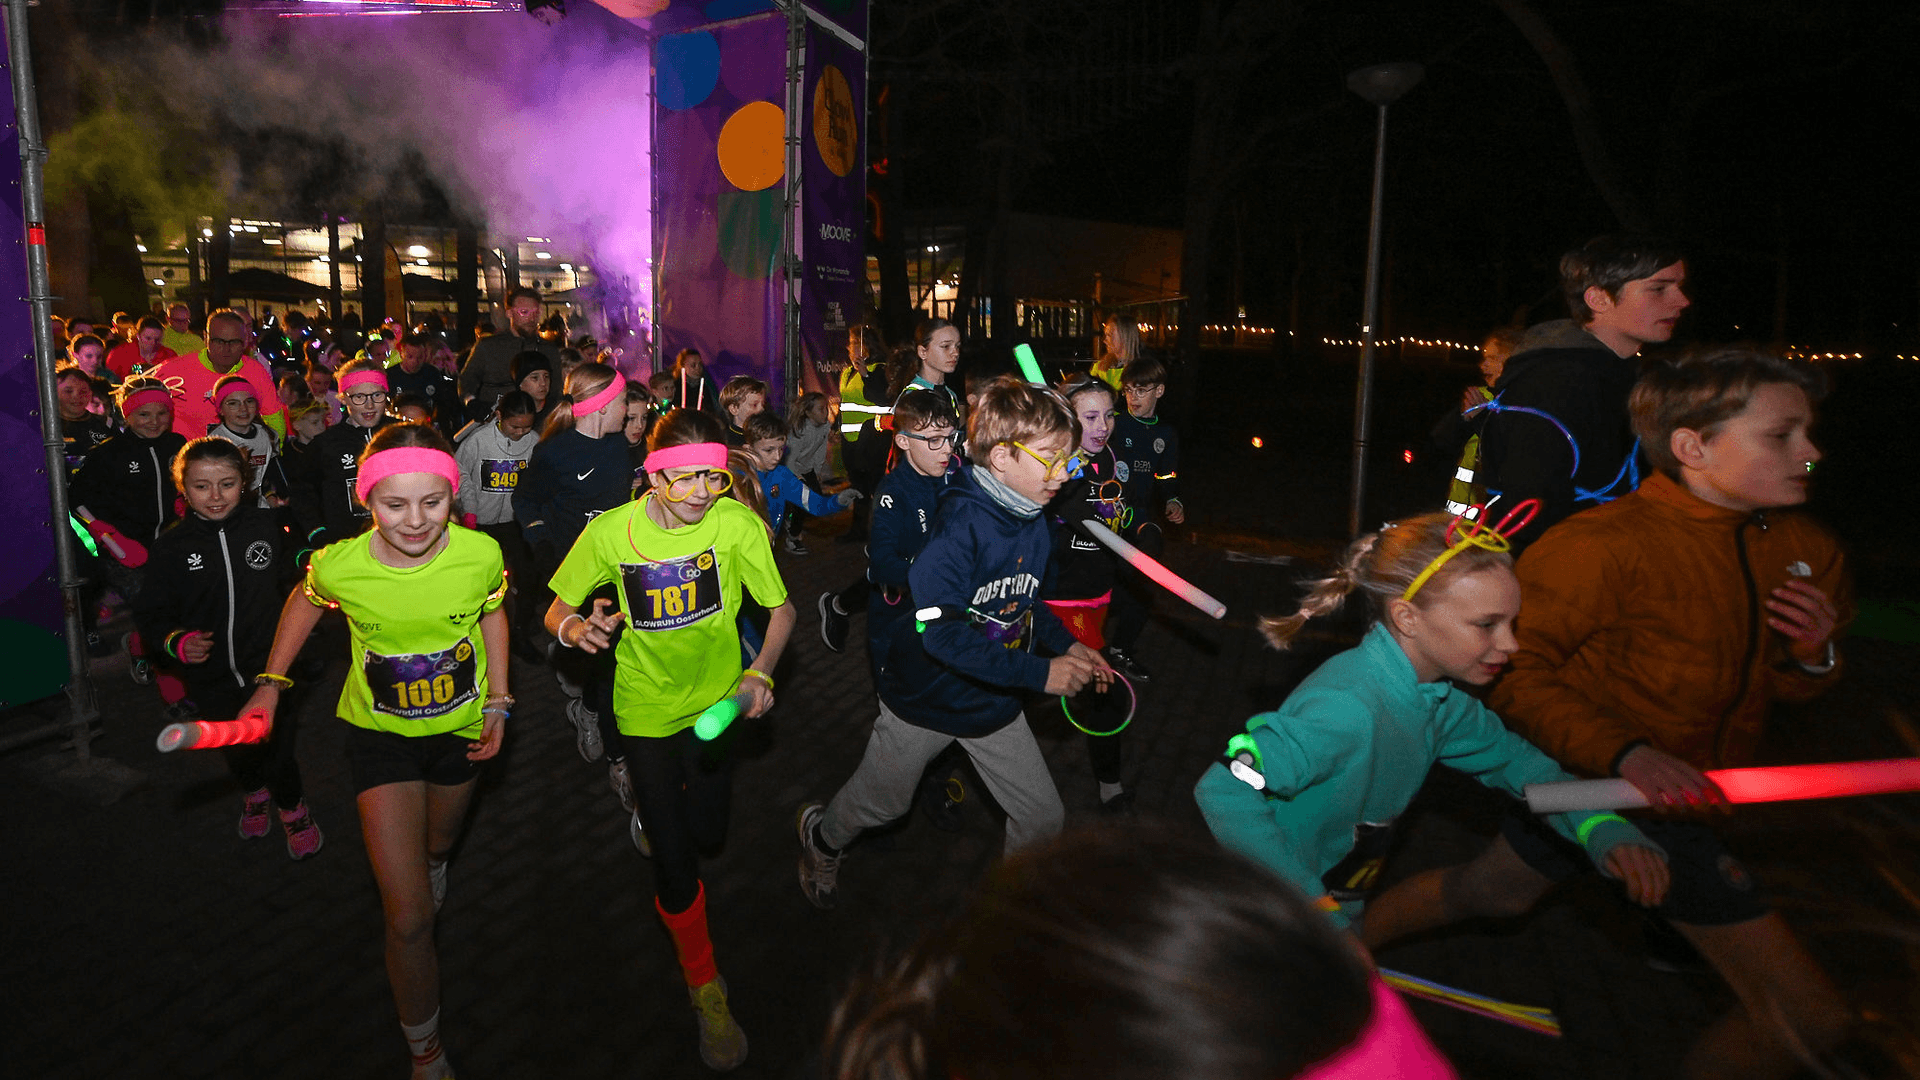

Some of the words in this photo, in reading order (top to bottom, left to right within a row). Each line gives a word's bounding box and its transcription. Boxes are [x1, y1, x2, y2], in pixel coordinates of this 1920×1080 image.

[821, 222, 852, 242] MOOVE
[490, 471, 519, 488] 349
[646, 581, 697, 619] 787
[675, 602, 719, 624] Oosterhout
[391, 673, 455, 709] 100
